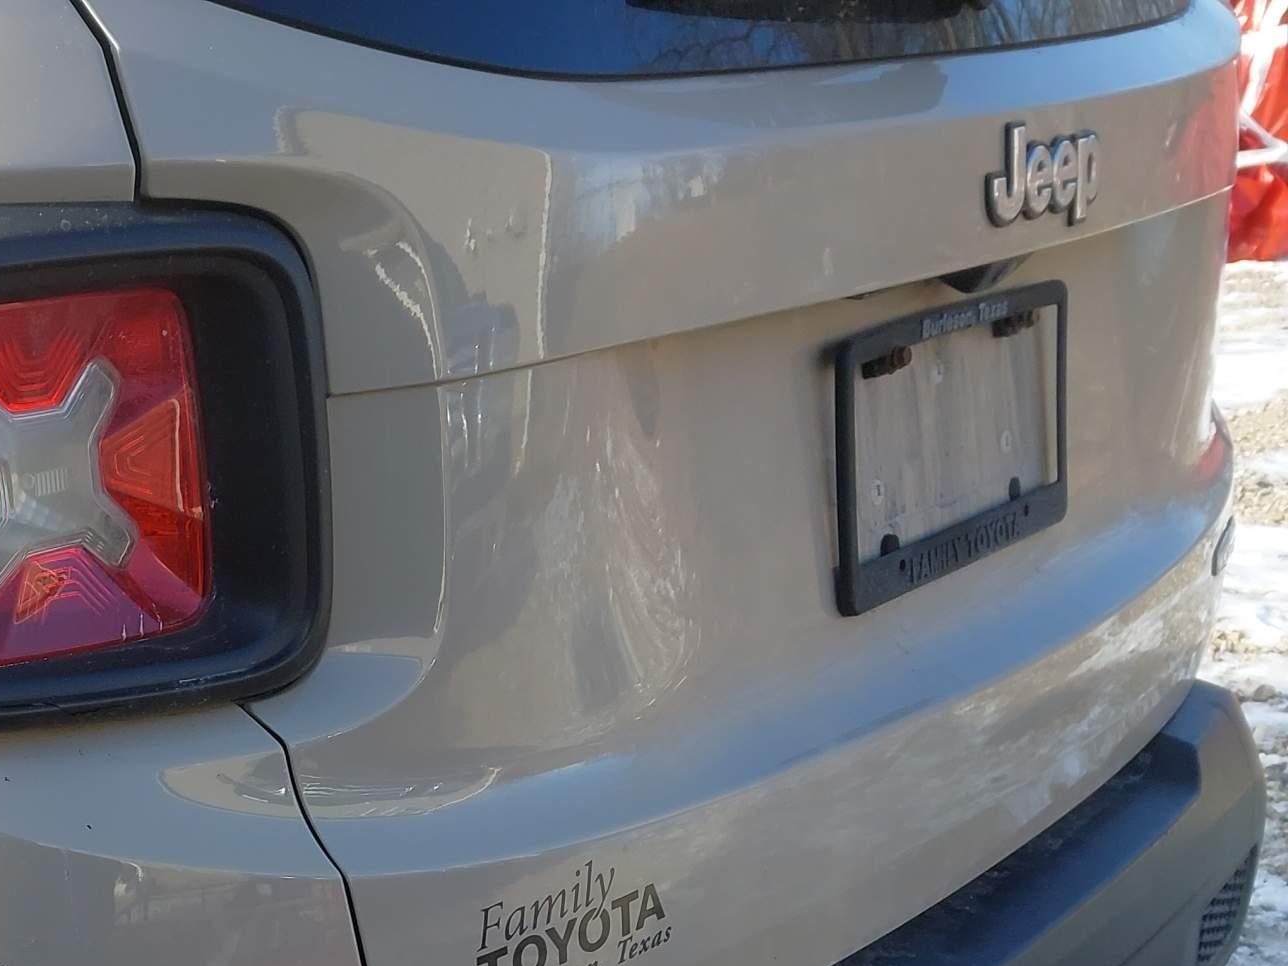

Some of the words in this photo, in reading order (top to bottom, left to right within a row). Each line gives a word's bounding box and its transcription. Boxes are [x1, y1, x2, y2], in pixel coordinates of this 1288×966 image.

[985, 121, 1098, 227] Jeep
[477, 860, 615, 952] Family
[618, 927, 671, 964] Texas
